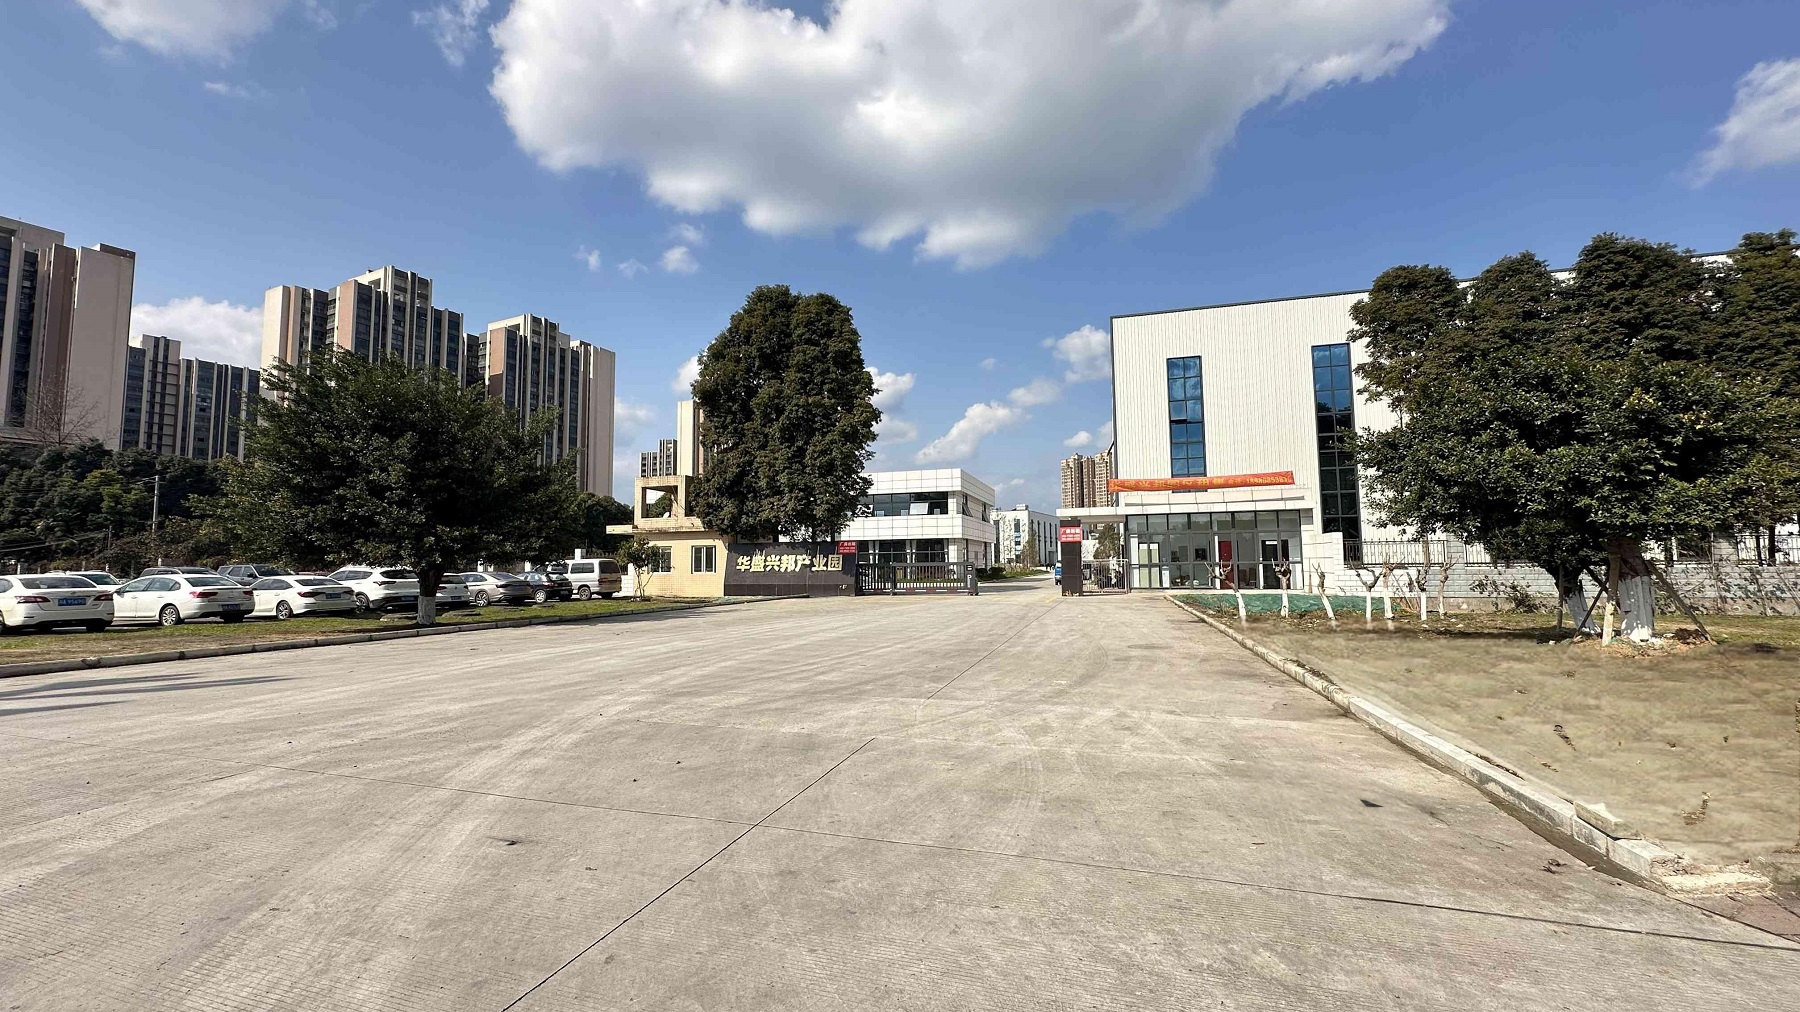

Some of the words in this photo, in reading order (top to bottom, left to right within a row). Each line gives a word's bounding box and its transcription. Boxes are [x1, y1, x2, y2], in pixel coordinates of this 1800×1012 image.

[736, 554, 842, 572] 华盛兴邦产业园
